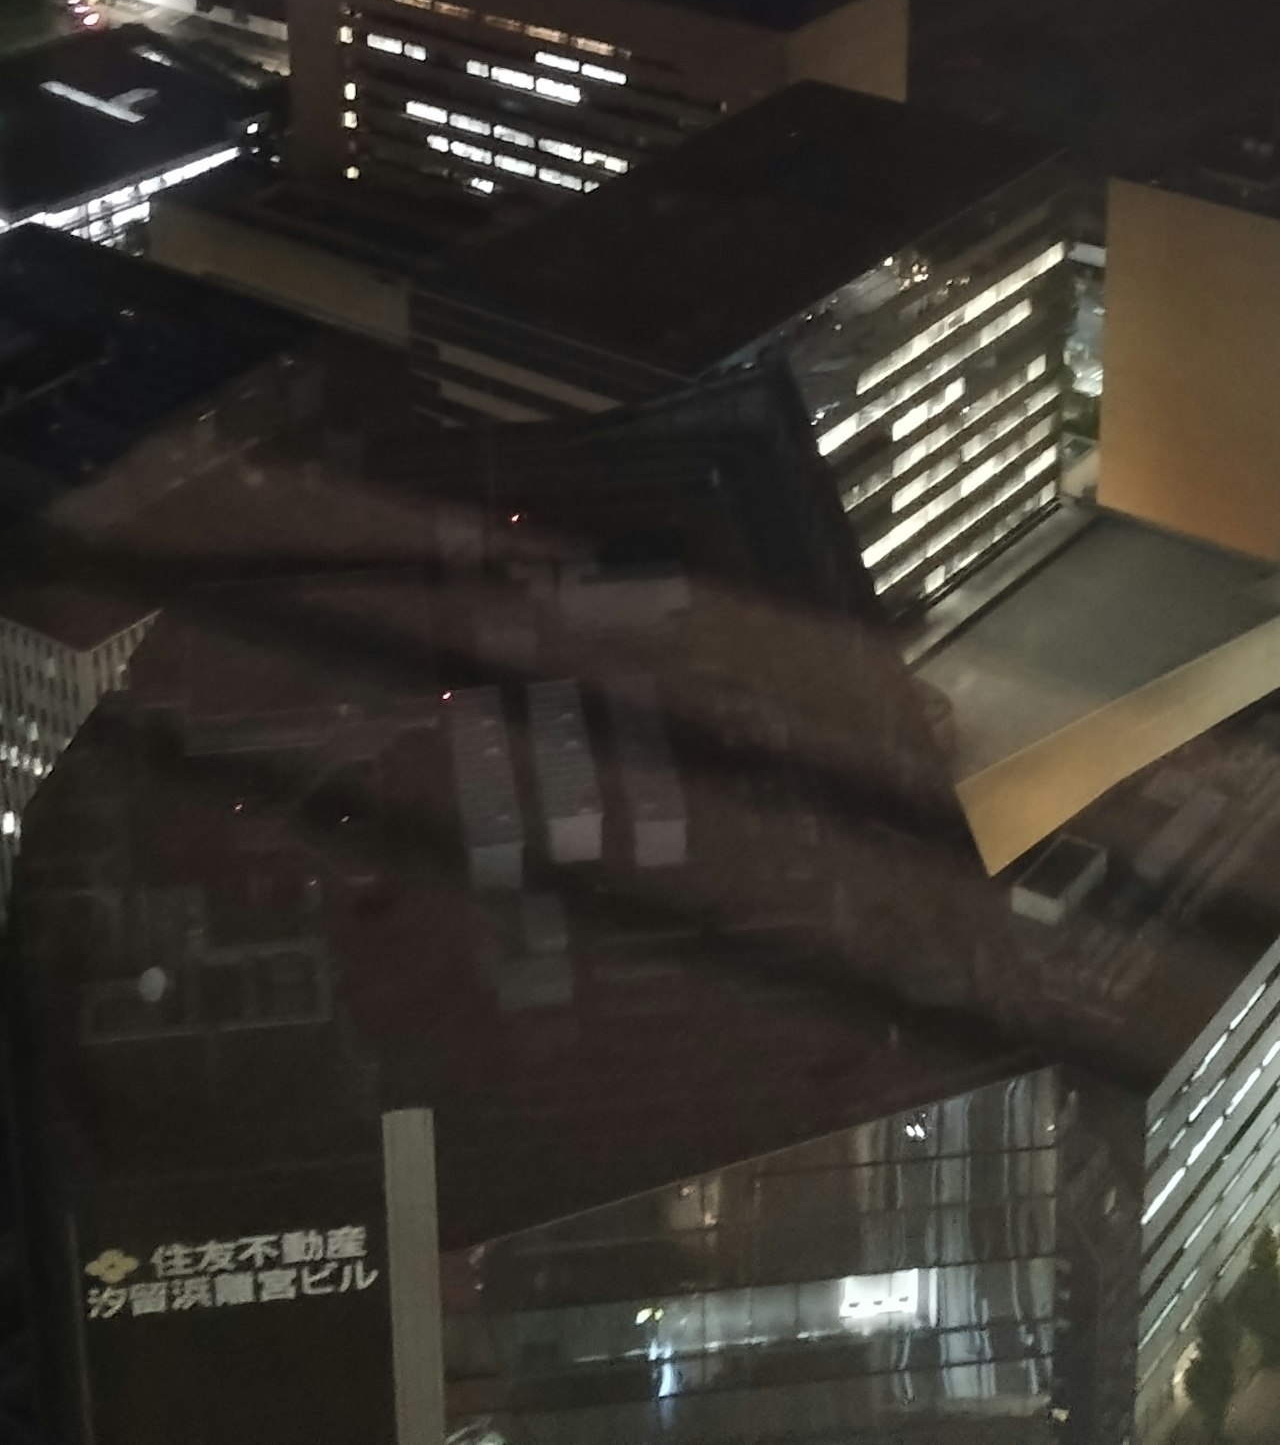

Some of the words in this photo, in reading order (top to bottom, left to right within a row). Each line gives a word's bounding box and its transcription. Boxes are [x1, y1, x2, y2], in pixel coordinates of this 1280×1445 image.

[151, 1225, 368, 1278] 住友不動産
